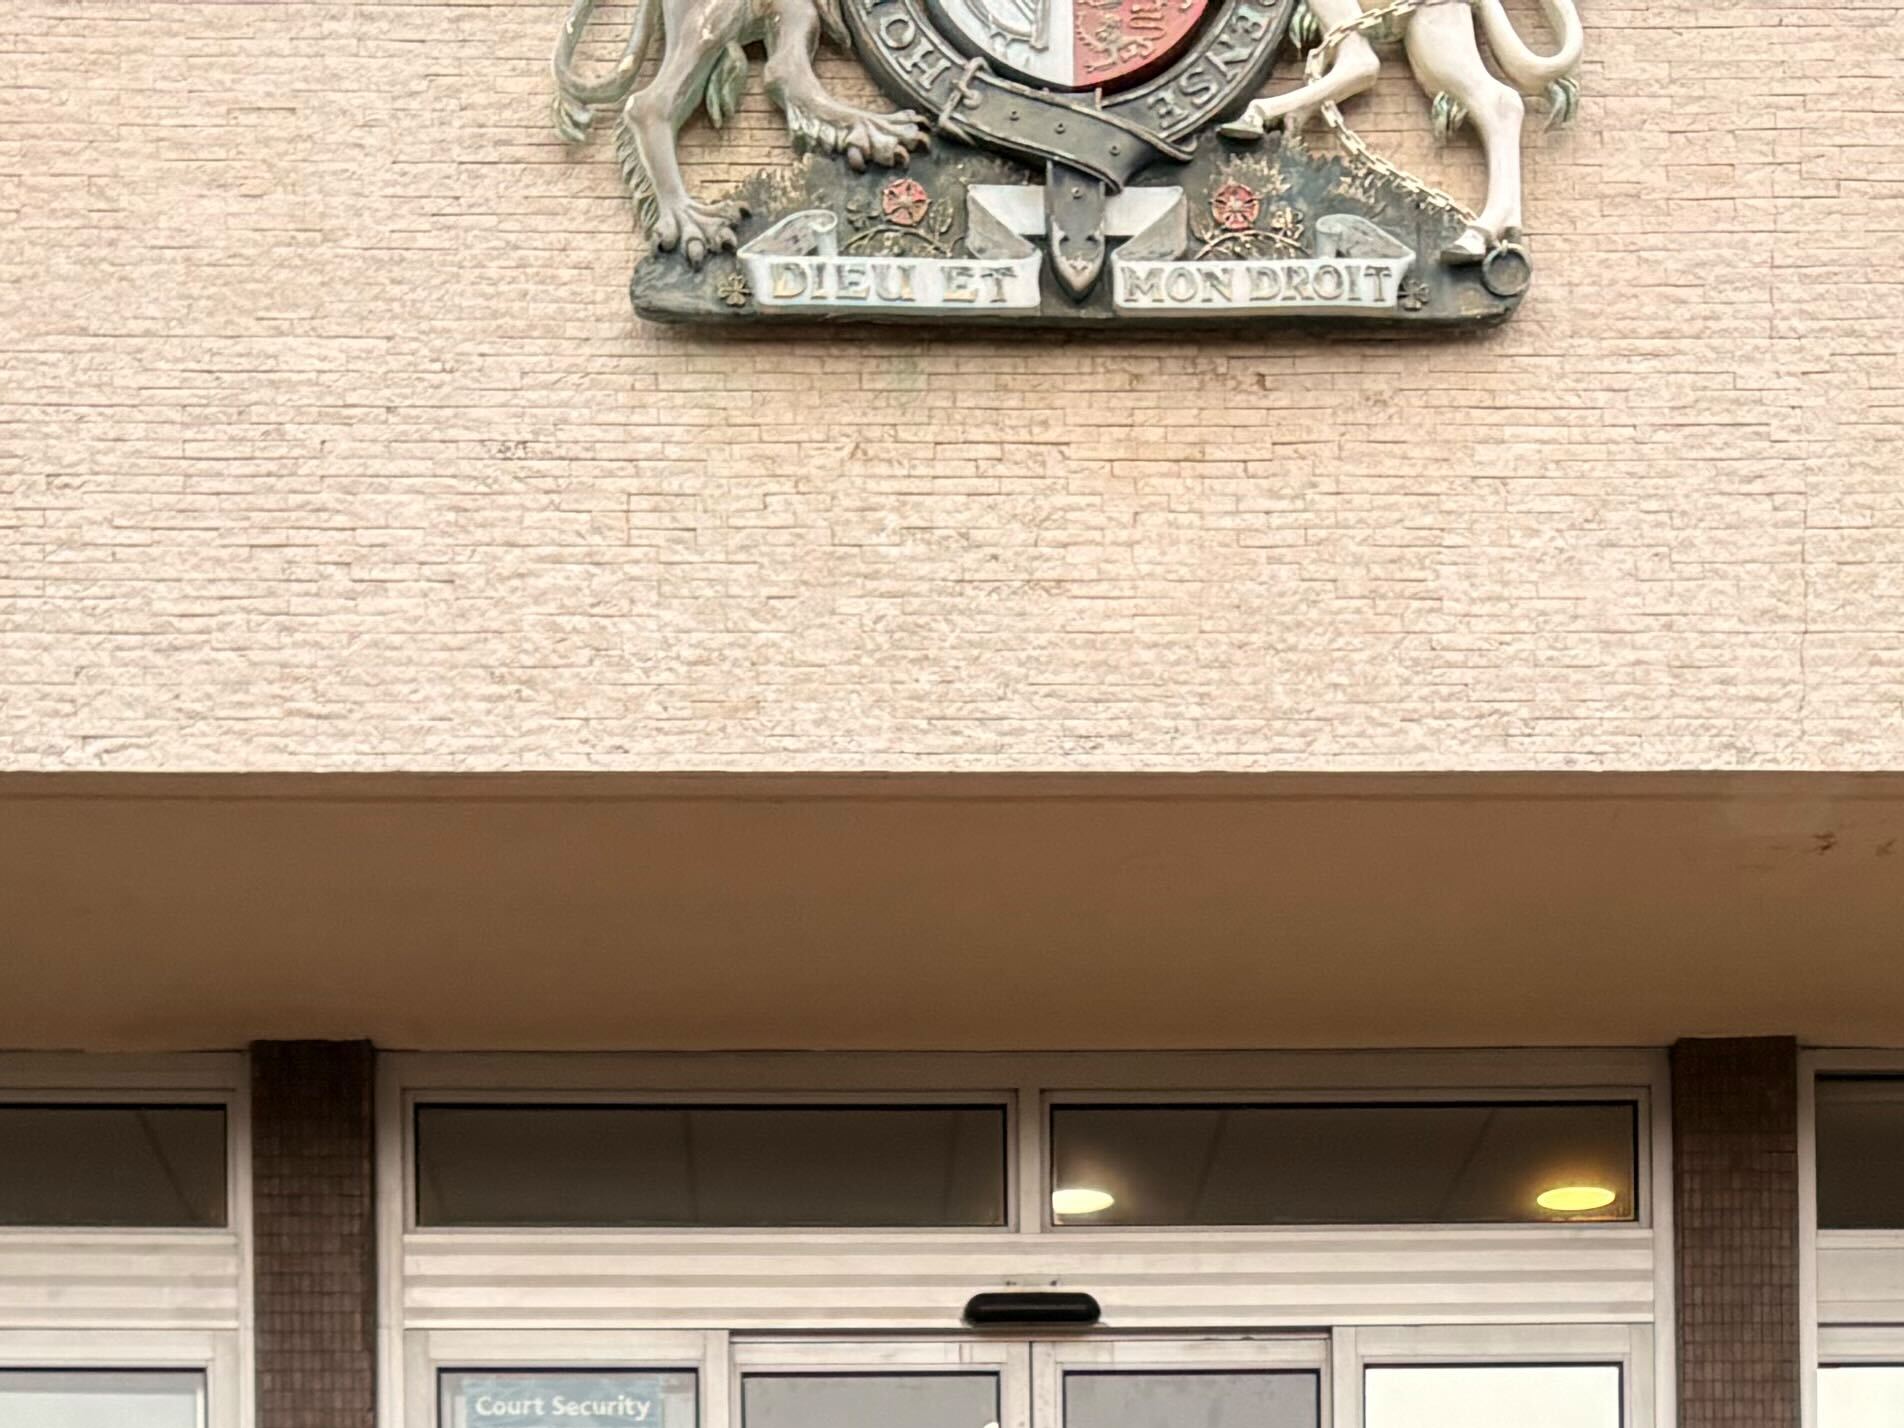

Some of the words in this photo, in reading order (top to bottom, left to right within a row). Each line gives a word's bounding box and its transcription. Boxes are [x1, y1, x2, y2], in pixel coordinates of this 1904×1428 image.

[771, 263, 917, 303] DIEU
[941, 267, 1017, 304] ET
[1122, 264, 1239, 304] MON
[1248, 264, 1393, 303] DROIT
[475, 1394, 545, 1417] Court
[552, 1394, 651, 1421] Security
